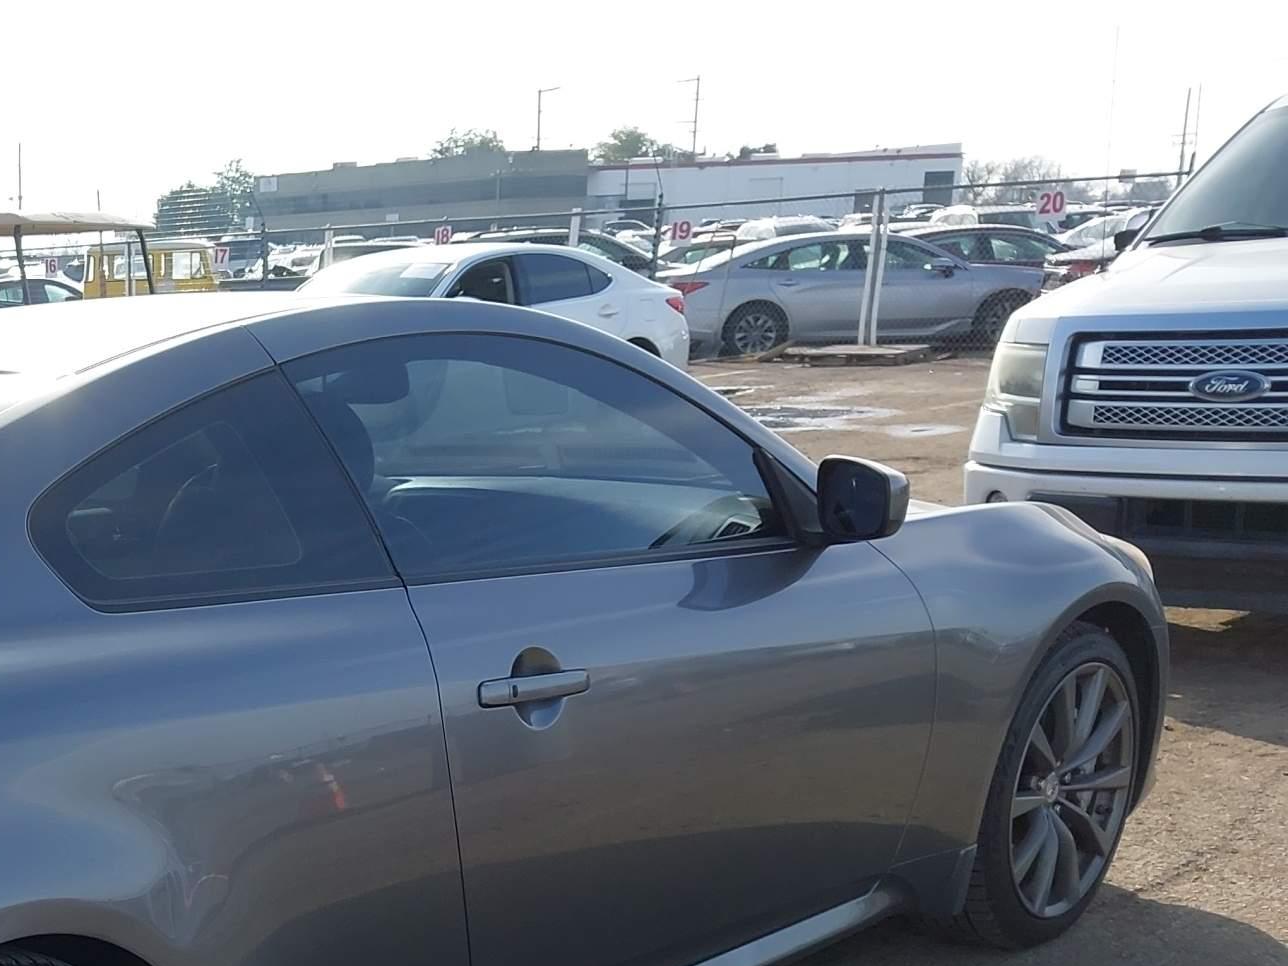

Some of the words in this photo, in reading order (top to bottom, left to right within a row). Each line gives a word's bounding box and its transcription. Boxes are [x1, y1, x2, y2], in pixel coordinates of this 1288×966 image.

[1038, 191, 1065, 215] 20
[435, 227, 450, 244] 18
[672, 221, 691, 241] 19
[214, 248, 228, 264] 17
[45, 259, 56, 274] 16
[1204, 375, 1250, 393] Ford
